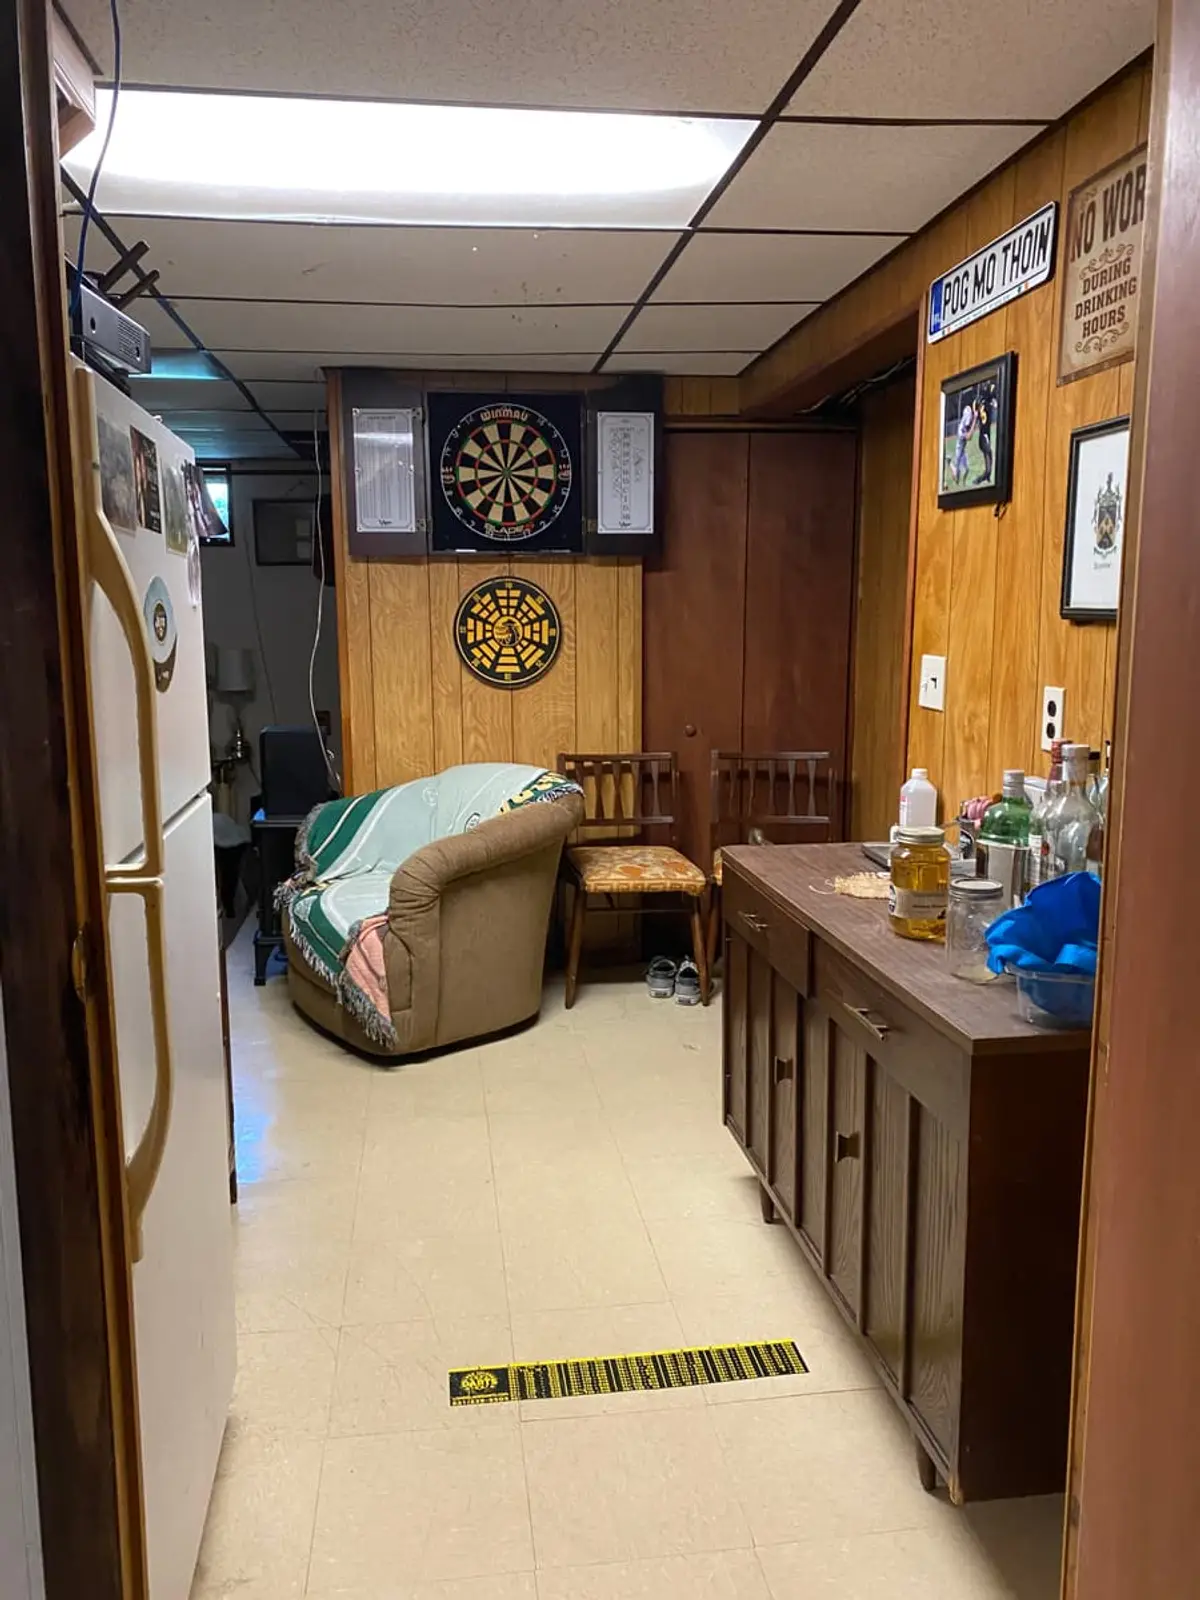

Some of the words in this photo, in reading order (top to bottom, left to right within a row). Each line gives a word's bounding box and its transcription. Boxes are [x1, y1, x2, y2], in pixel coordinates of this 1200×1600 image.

[1070, 201, 1097, 262] NO
[943, 270, 970, 321] POG
[972, 253, 996, 304] MO
[1002, 217, 1051, 286] THOIN
[1083, 257, 1131, 295] DURING
[1075, 277, 1137, 320] DRINKING
[1082, 305, 1126, 338] HOURS
